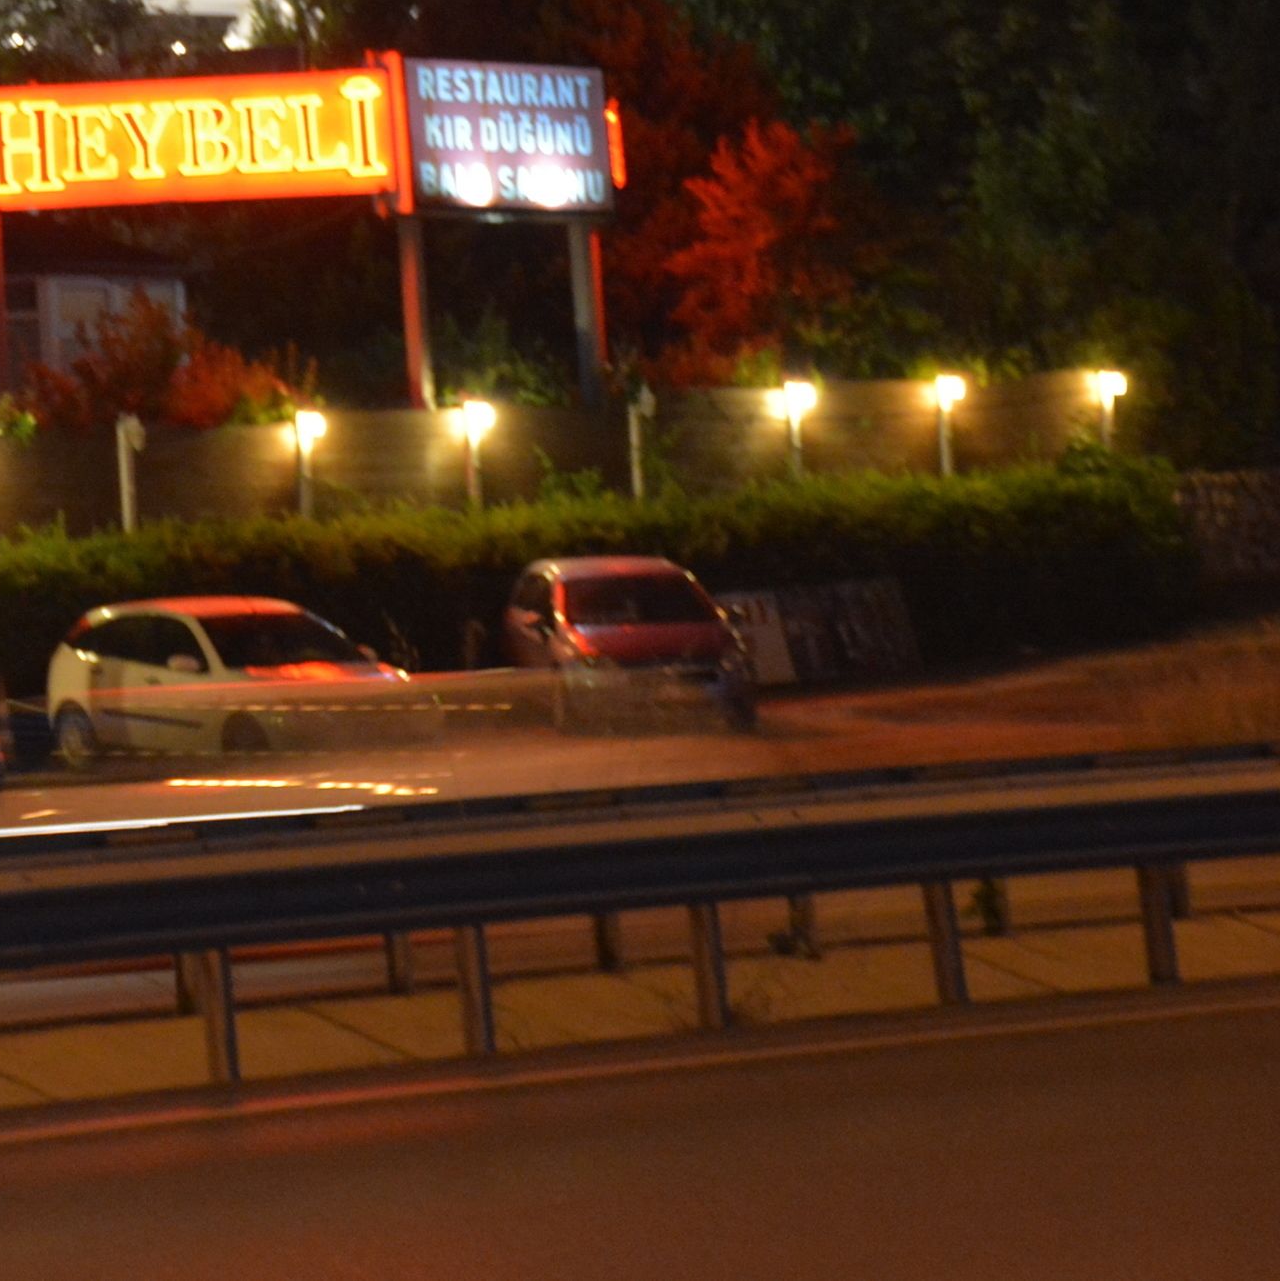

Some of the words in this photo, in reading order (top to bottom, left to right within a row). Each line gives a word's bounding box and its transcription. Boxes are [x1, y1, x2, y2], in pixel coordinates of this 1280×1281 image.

[416, 66, 591, 108] RESTAURANT
[424, 113, 474, 151] KIR
[479, 110, 593, 157] DÜĞÜNÜ
